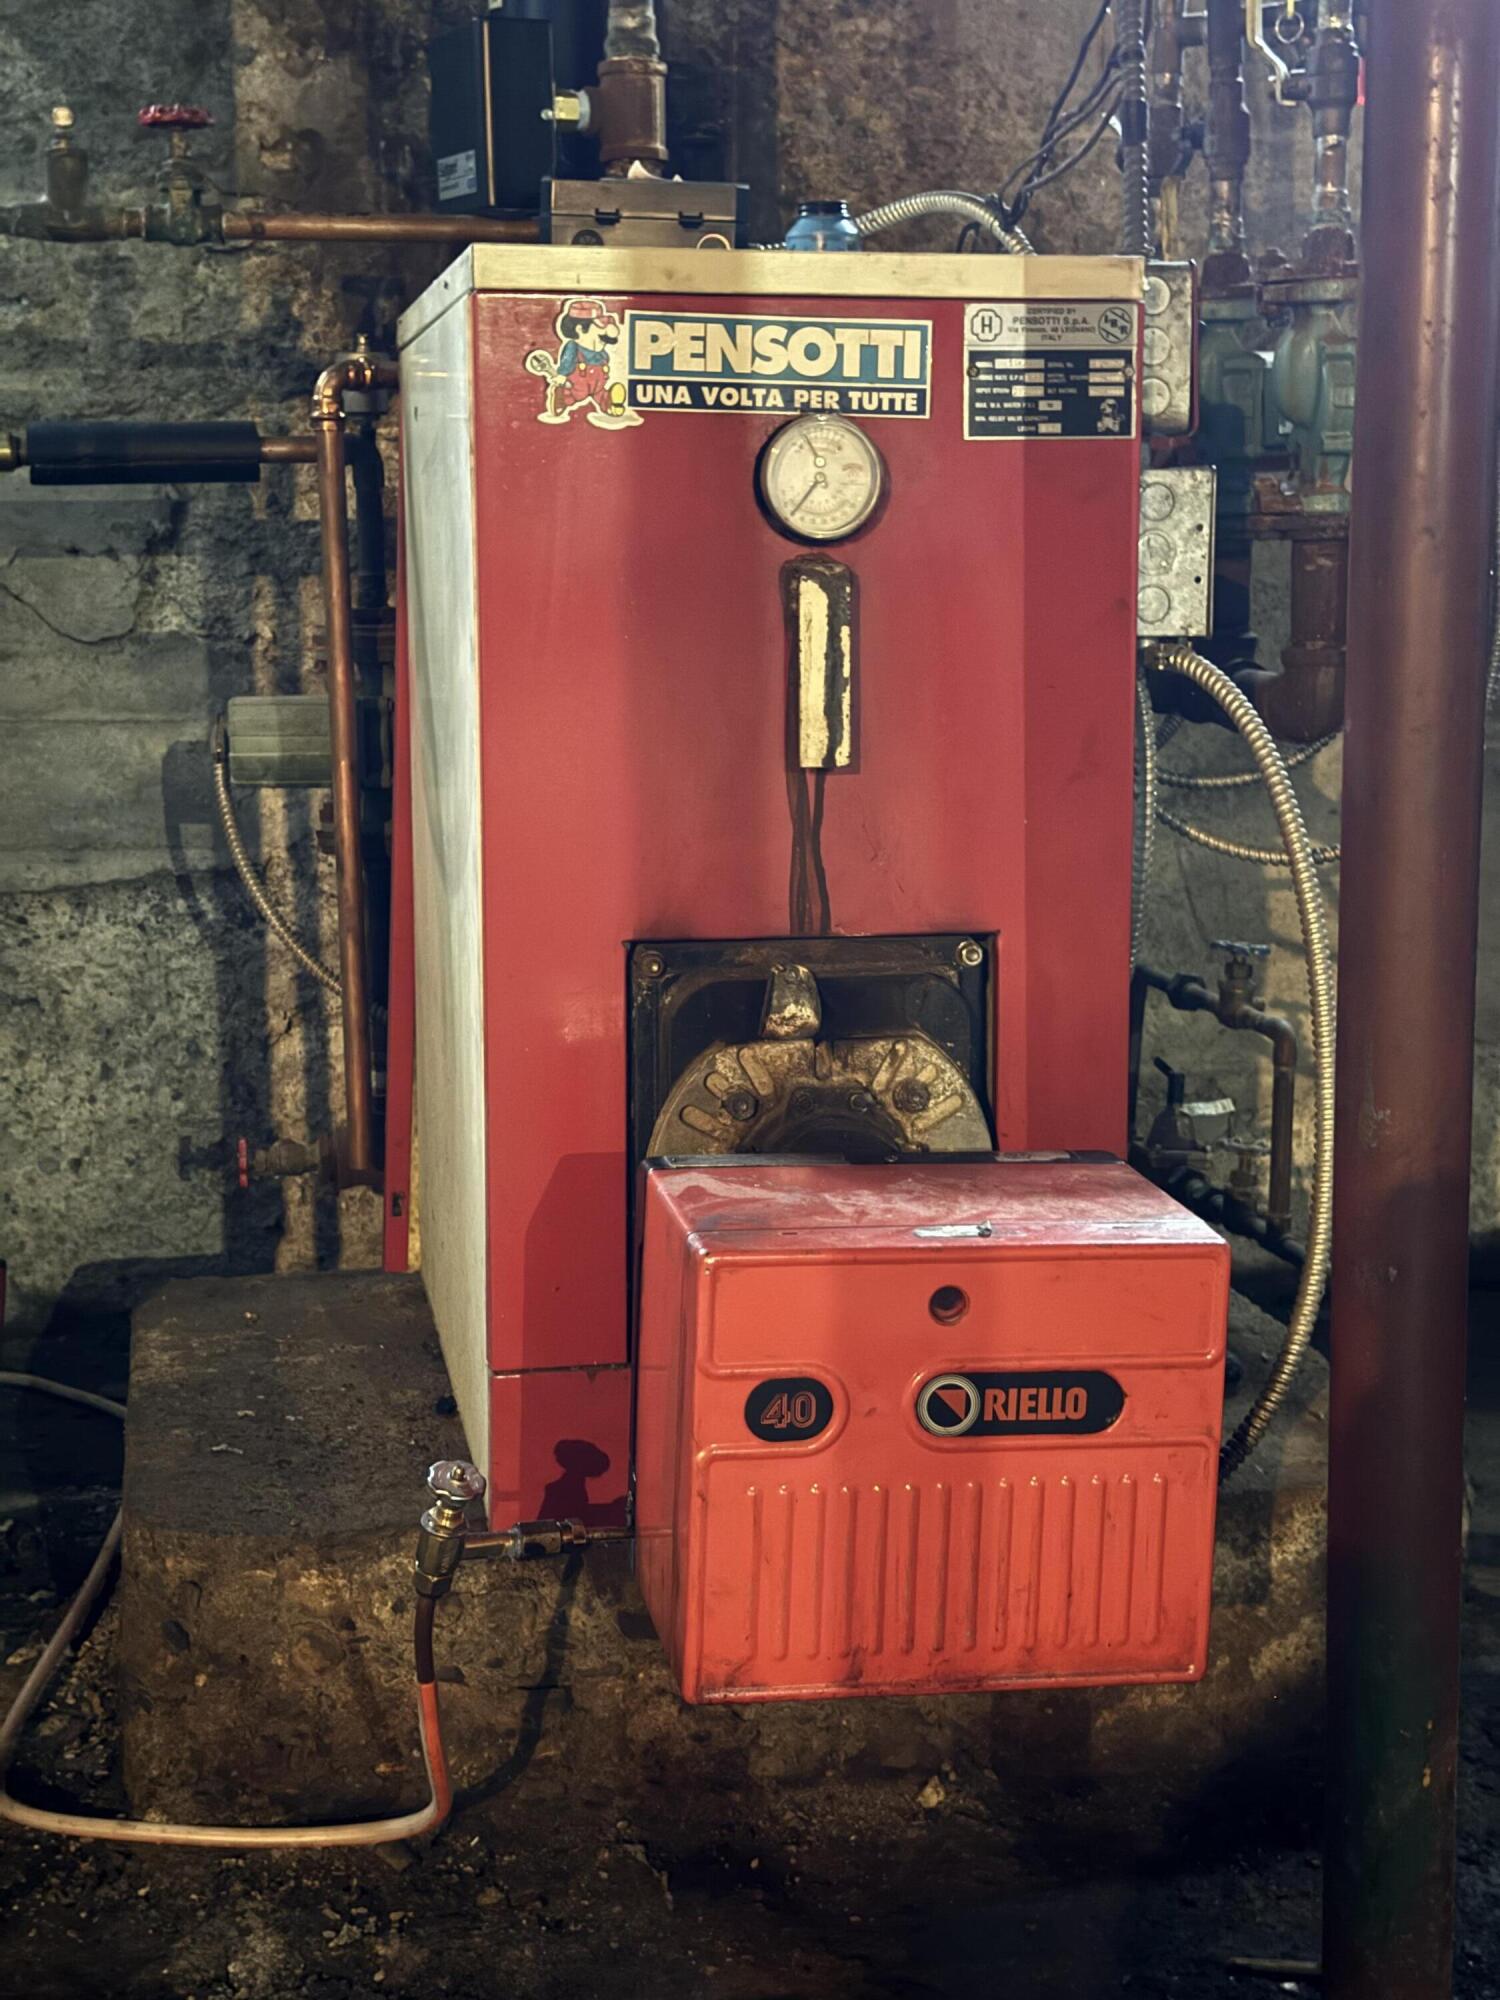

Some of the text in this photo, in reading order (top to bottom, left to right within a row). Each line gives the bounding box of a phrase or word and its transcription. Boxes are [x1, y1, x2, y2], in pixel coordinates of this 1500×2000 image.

[981, 316, 993, 333] H
[1012, 316, 1061, 325] PENSOTTI
[634, 320, 921, 378] PENSOTTI
[635, 383, 918, 412] UNA VOLTA PER TUTTE
[760, 1390, 817, 1429] 40
[984, 1386, 1088, 1422] RIELLO
